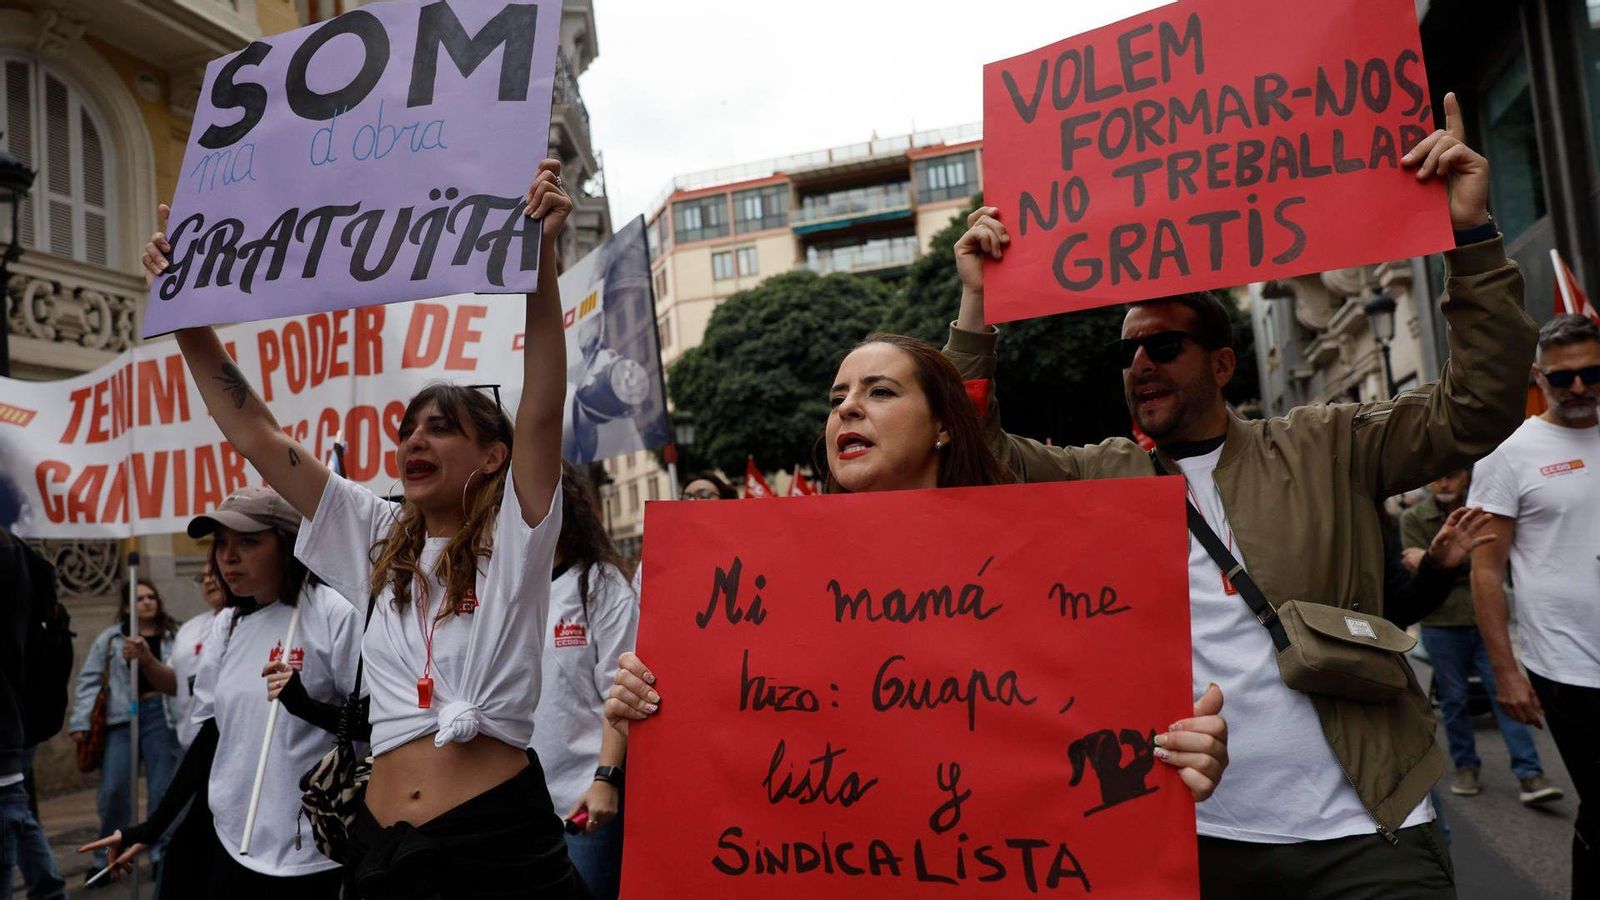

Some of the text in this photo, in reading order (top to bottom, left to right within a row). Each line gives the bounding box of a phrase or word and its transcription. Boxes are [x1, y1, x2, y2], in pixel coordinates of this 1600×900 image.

[197, 0, 538, 149] SOM
[1001, 12, 1205, 124] VOLEM
[191, 143, 257, 194] ma
[1019, 175, 1089, 236] NO
[158, 187, 538, 301] GRATUÏTA
[257, 303, 386, 403] PODER
[401, 302, 488, 371] DE
[696, 556, 1132, 629] Mi mamá me
[762, 740, 972, 834] lista y
